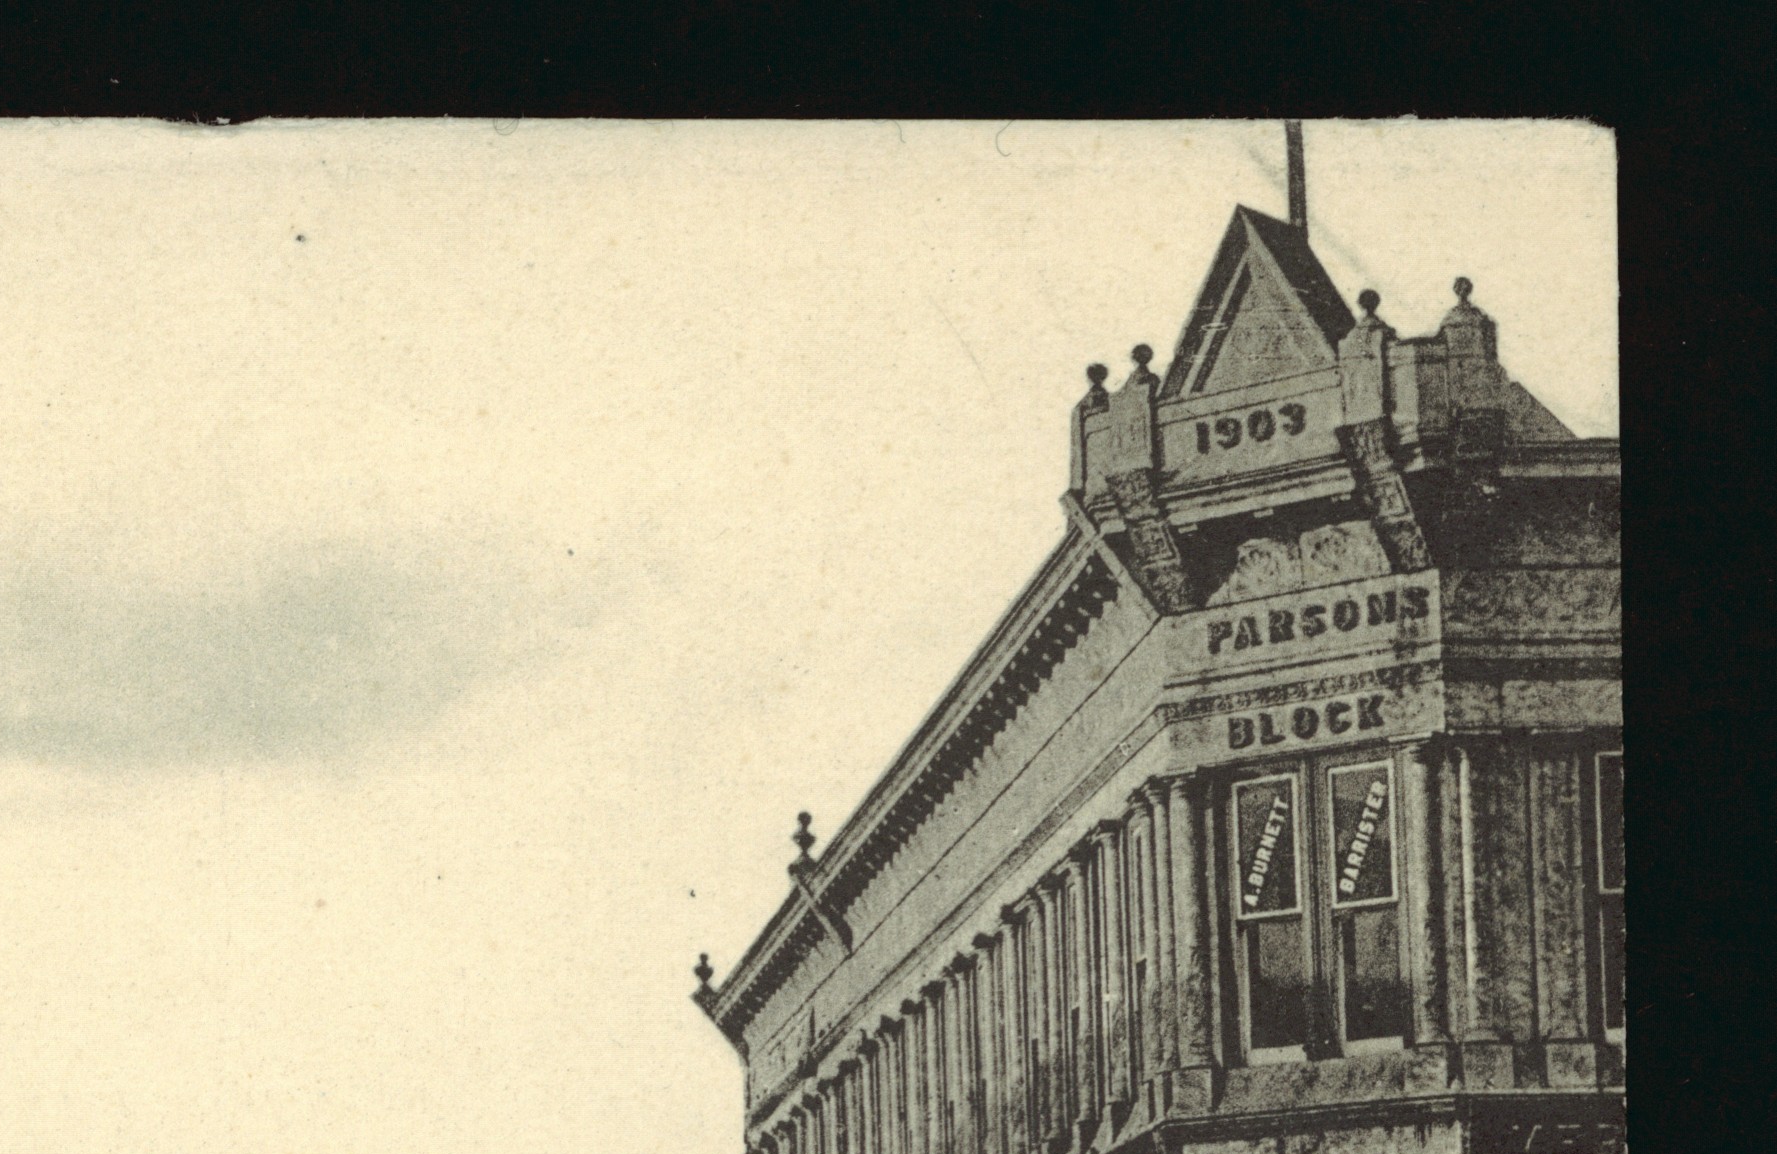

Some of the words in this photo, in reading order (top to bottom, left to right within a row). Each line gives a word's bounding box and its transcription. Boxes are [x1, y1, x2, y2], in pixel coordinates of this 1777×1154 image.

[1195, 402, 1307, 454] 1903
[1207, 586, 1429, 655] PARSONS
[1227, 694, 1386, 750] BLOCK
[1338, 780, 1387, 894] BARRISTER
